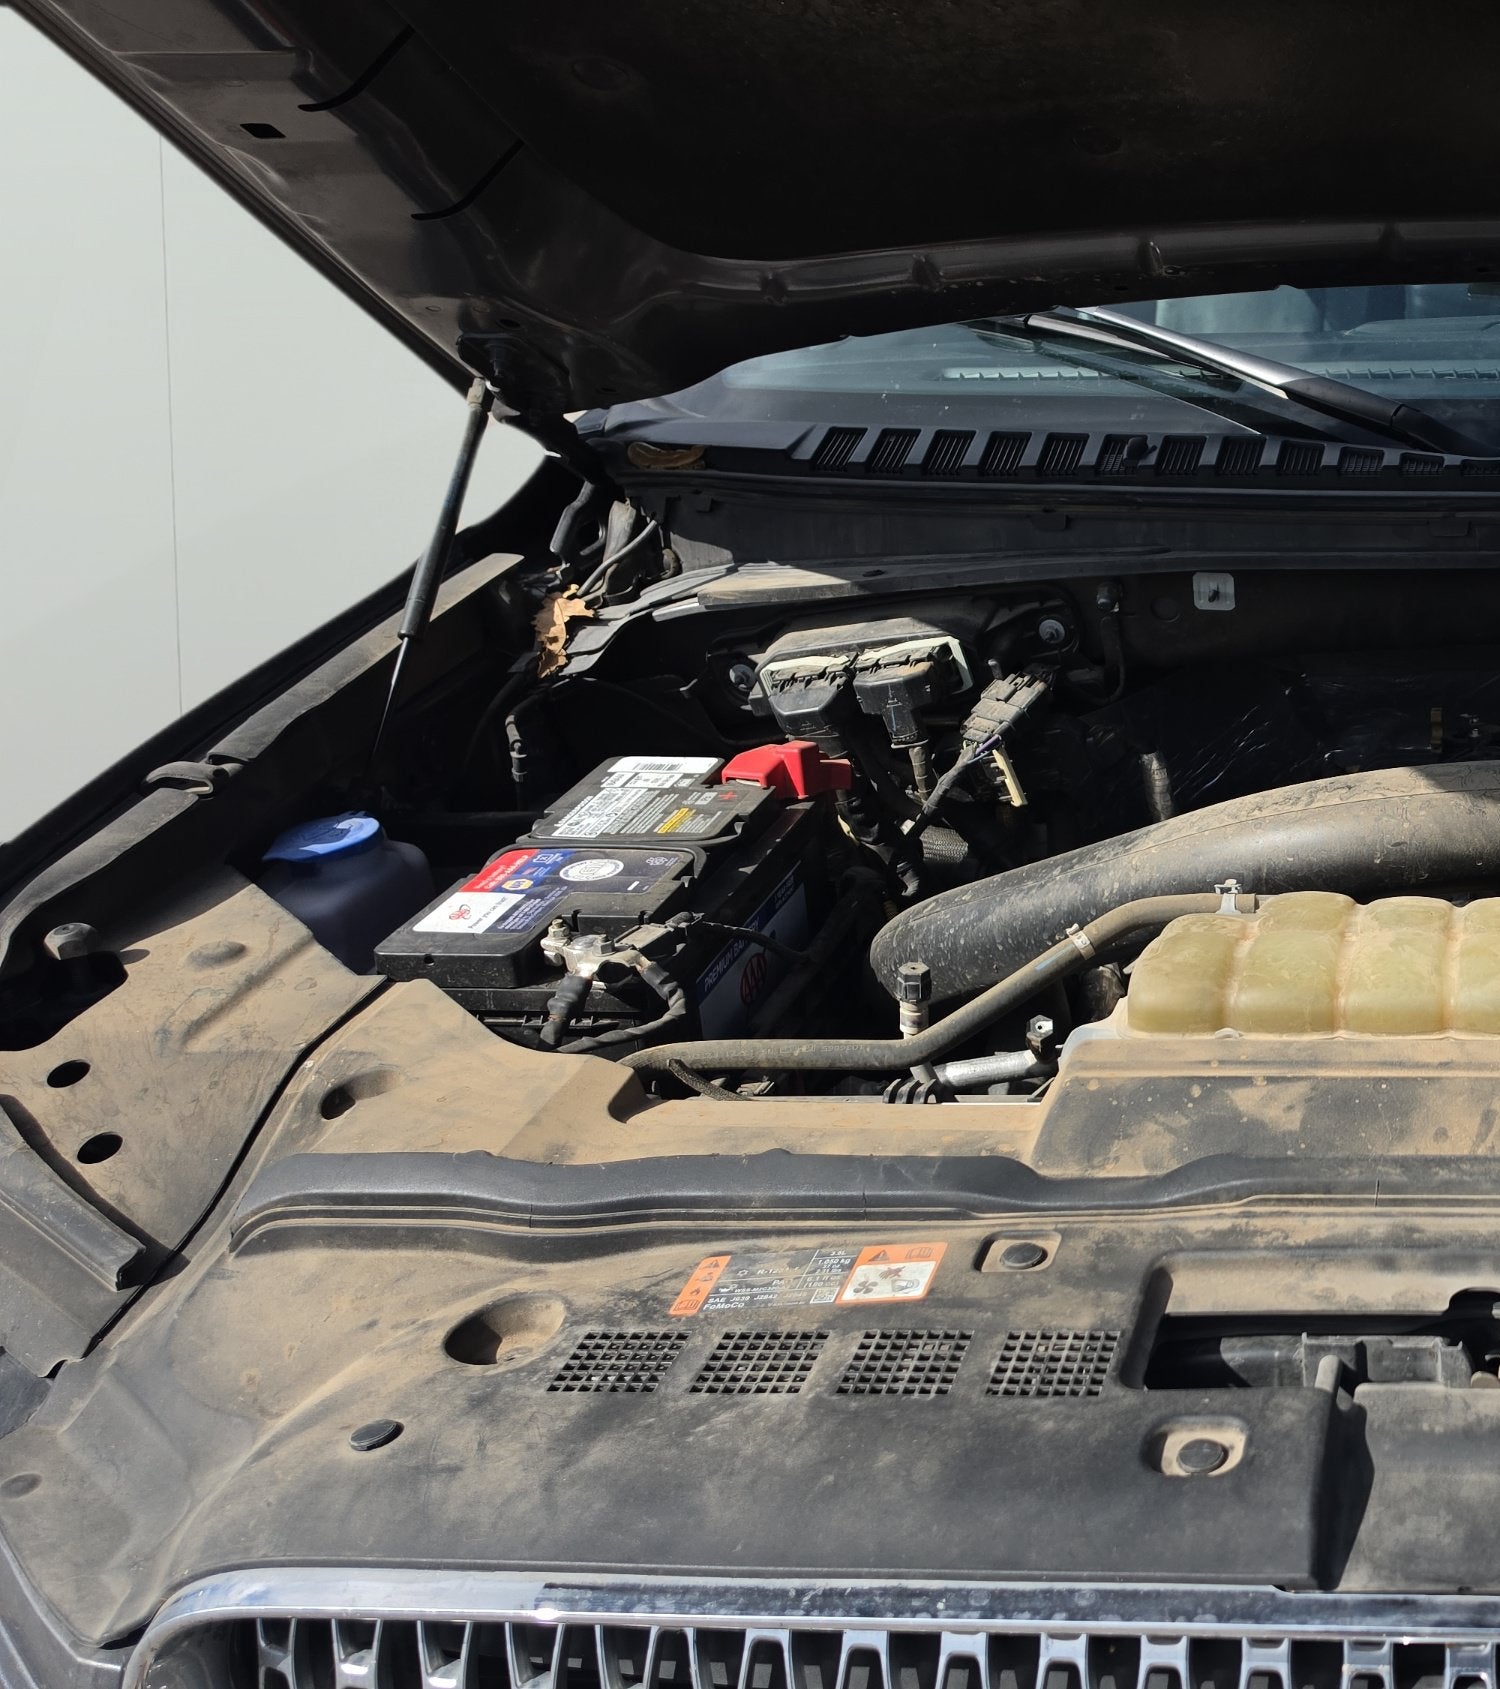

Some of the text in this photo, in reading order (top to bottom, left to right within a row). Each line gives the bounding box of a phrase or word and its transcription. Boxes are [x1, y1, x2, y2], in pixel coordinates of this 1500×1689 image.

[704, 951, 733, 992] PREMIUM
[741, 954, 767, 1004] AAA
[703, 1302, 745, 1310] FoMoCo
